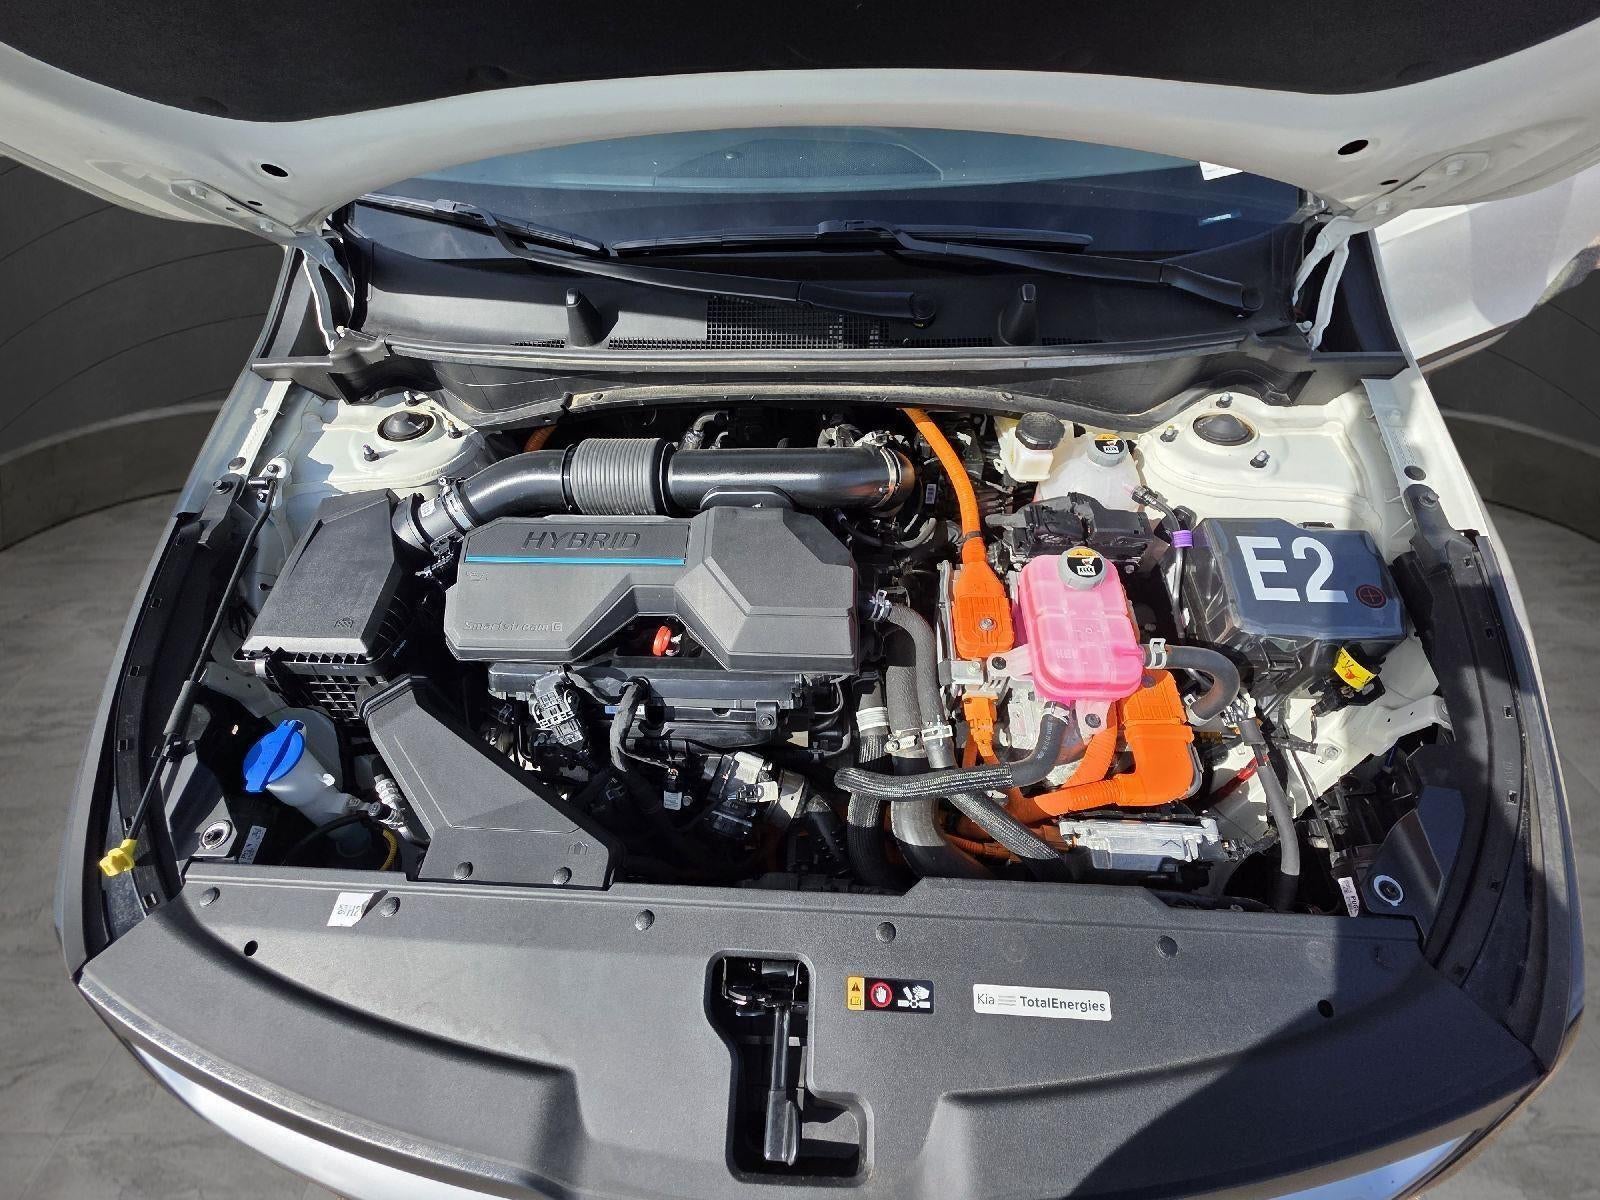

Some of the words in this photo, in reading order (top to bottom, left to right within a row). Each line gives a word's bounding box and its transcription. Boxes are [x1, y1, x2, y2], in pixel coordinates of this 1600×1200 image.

[521, 531, 641, 550] HYBRID
[1236, 536, 1348, 602] E2
[977, 993, 995, 1006] Kia
[1019, 996, 1106, 1013] TotalEnergies
